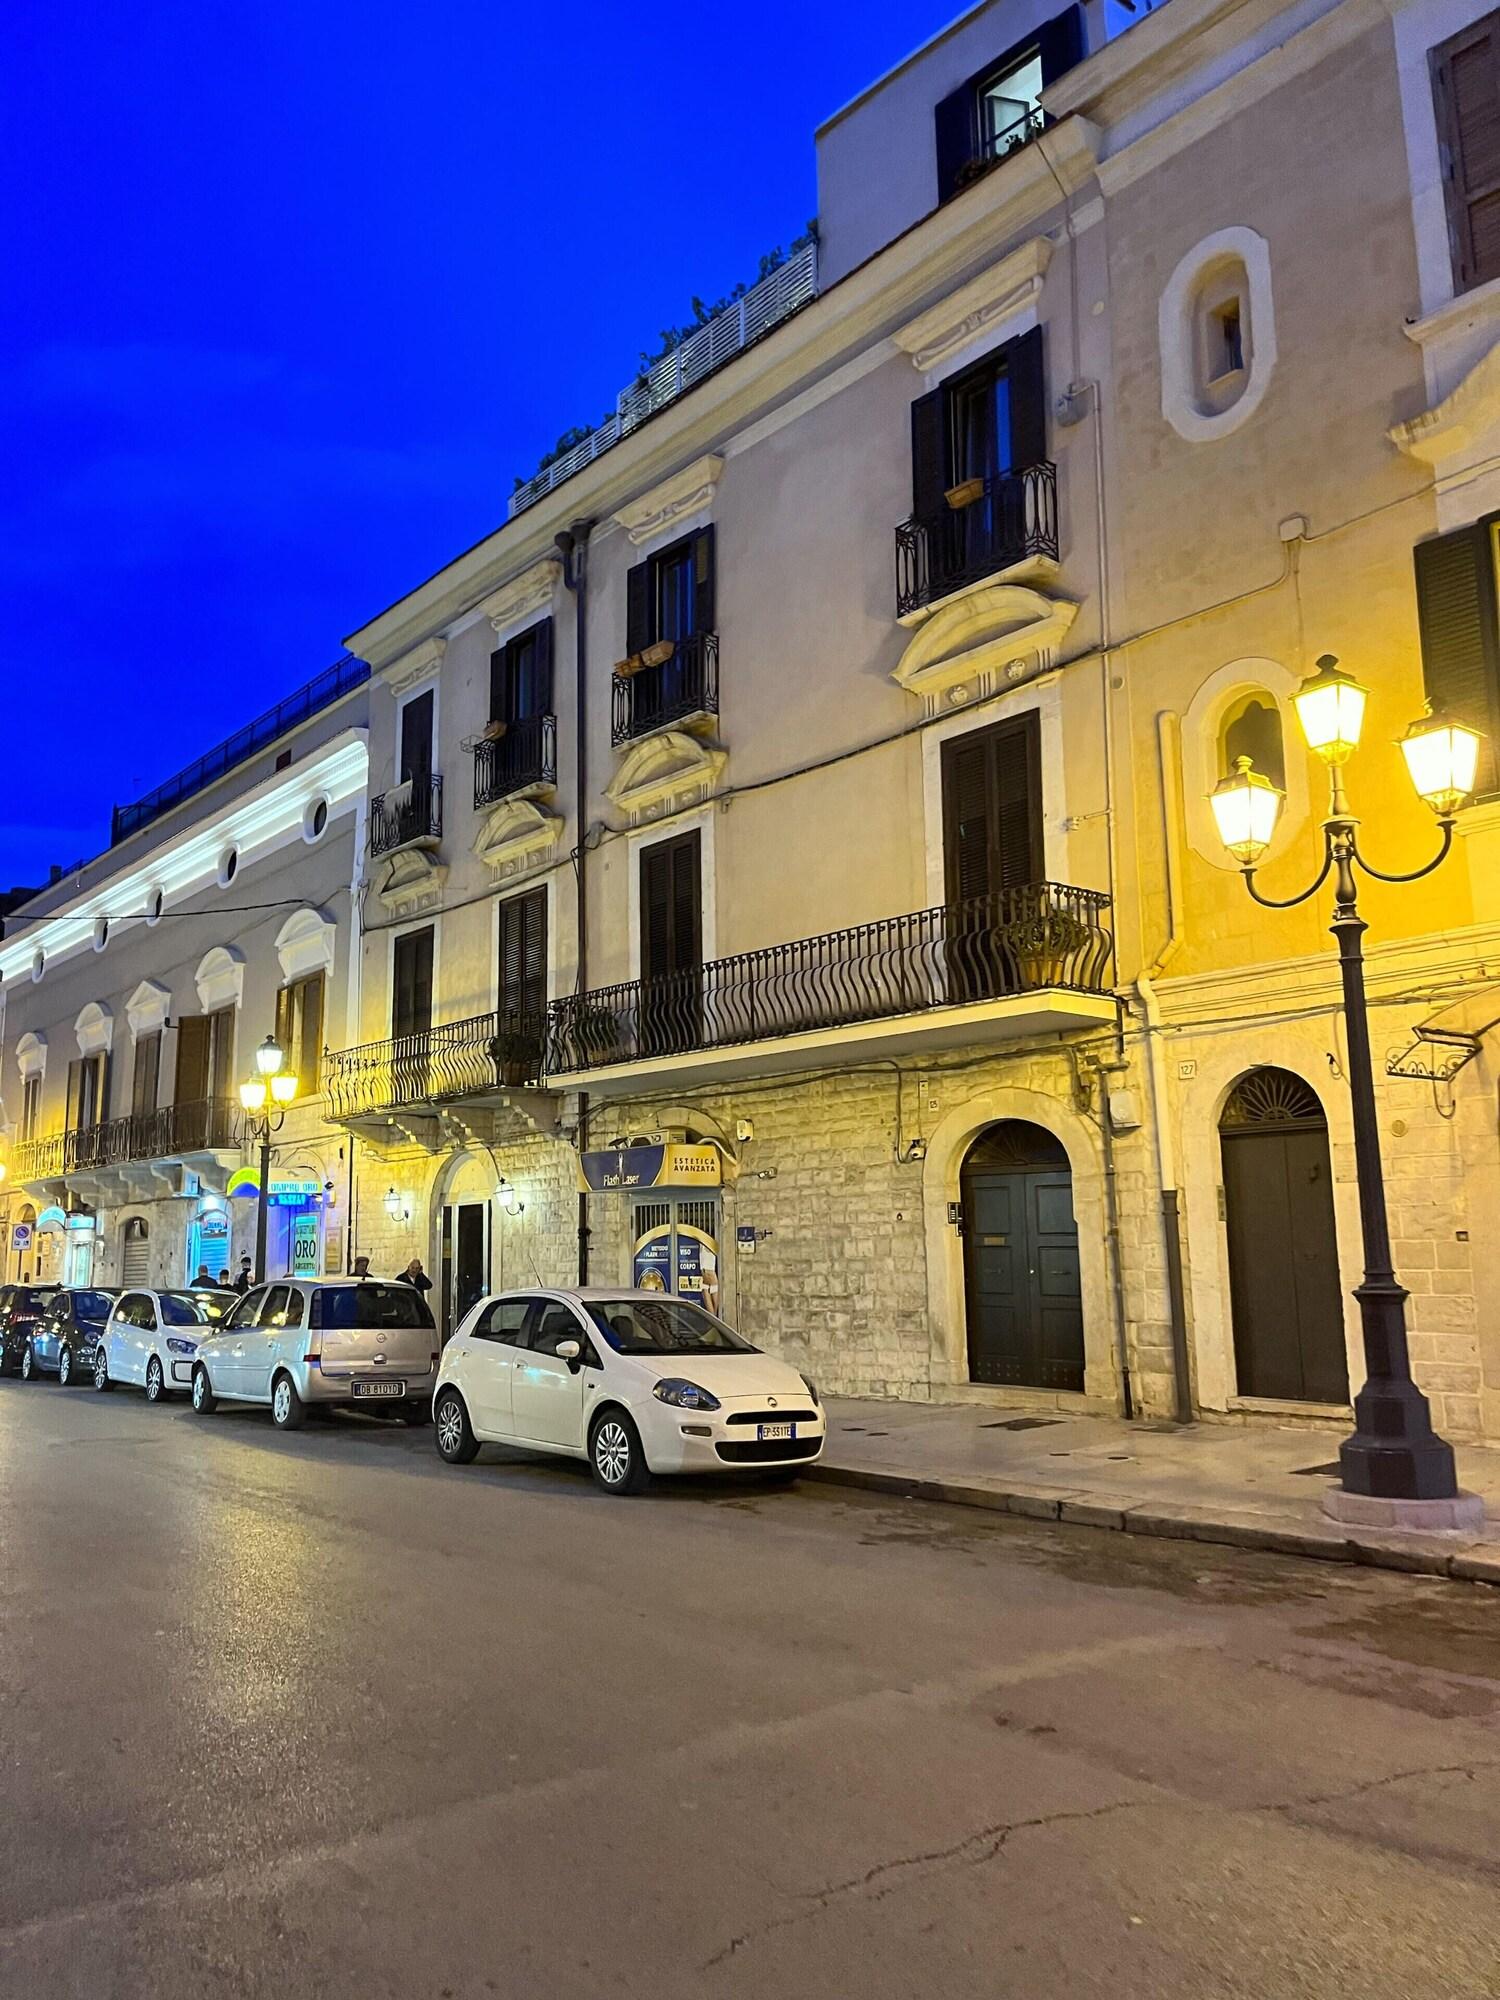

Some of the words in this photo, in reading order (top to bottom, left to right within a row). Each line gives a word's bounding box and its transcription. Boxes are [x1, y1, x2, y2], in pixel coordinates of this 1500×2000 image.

[1180, 1064, 1194, 1075] 127
[674, 1157, 715, 1165] ESTETICA
[603, 1174, 620, 1187] Flash
[621, 1174, 640, 1185] Laser
[295, 1239, 316, 1258] ORO
